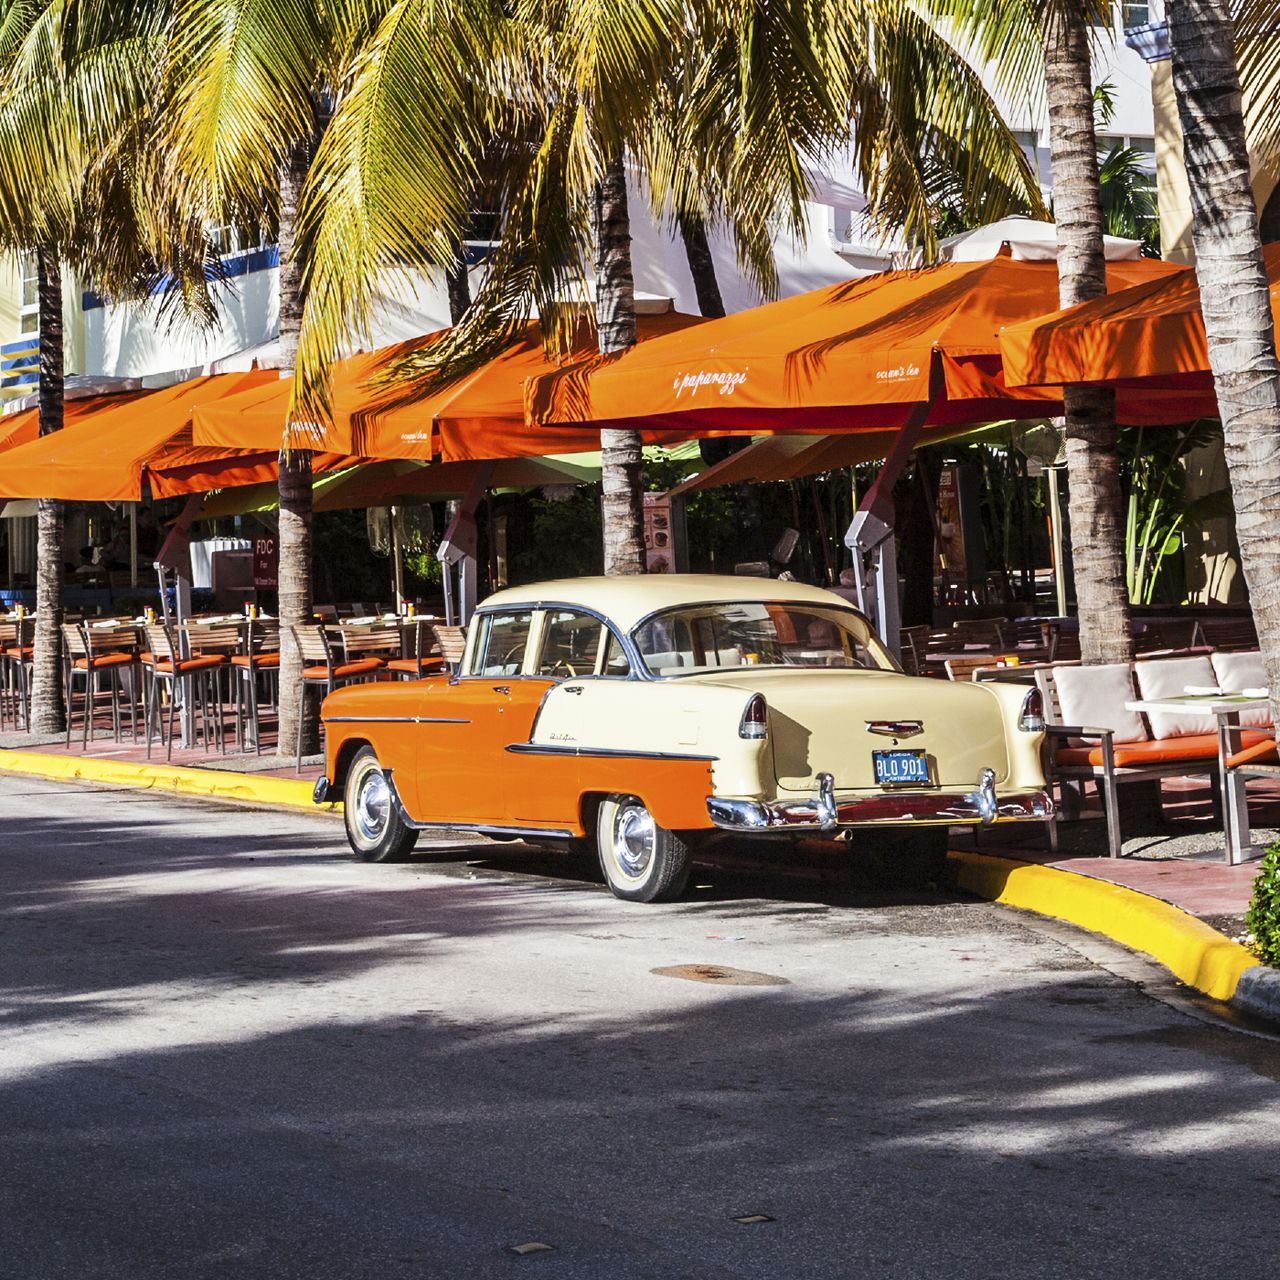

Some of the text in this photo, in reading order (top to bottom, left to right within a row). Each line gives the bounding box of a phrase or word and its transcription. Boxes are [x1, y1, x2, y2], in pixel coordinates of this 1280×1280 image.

[876, 363, 920, 380] ocean's ten
[676, 367, 749, 399] paparazzi
[256, 539, 274, 555] FDC
[901, 759, 924, 775] 901
